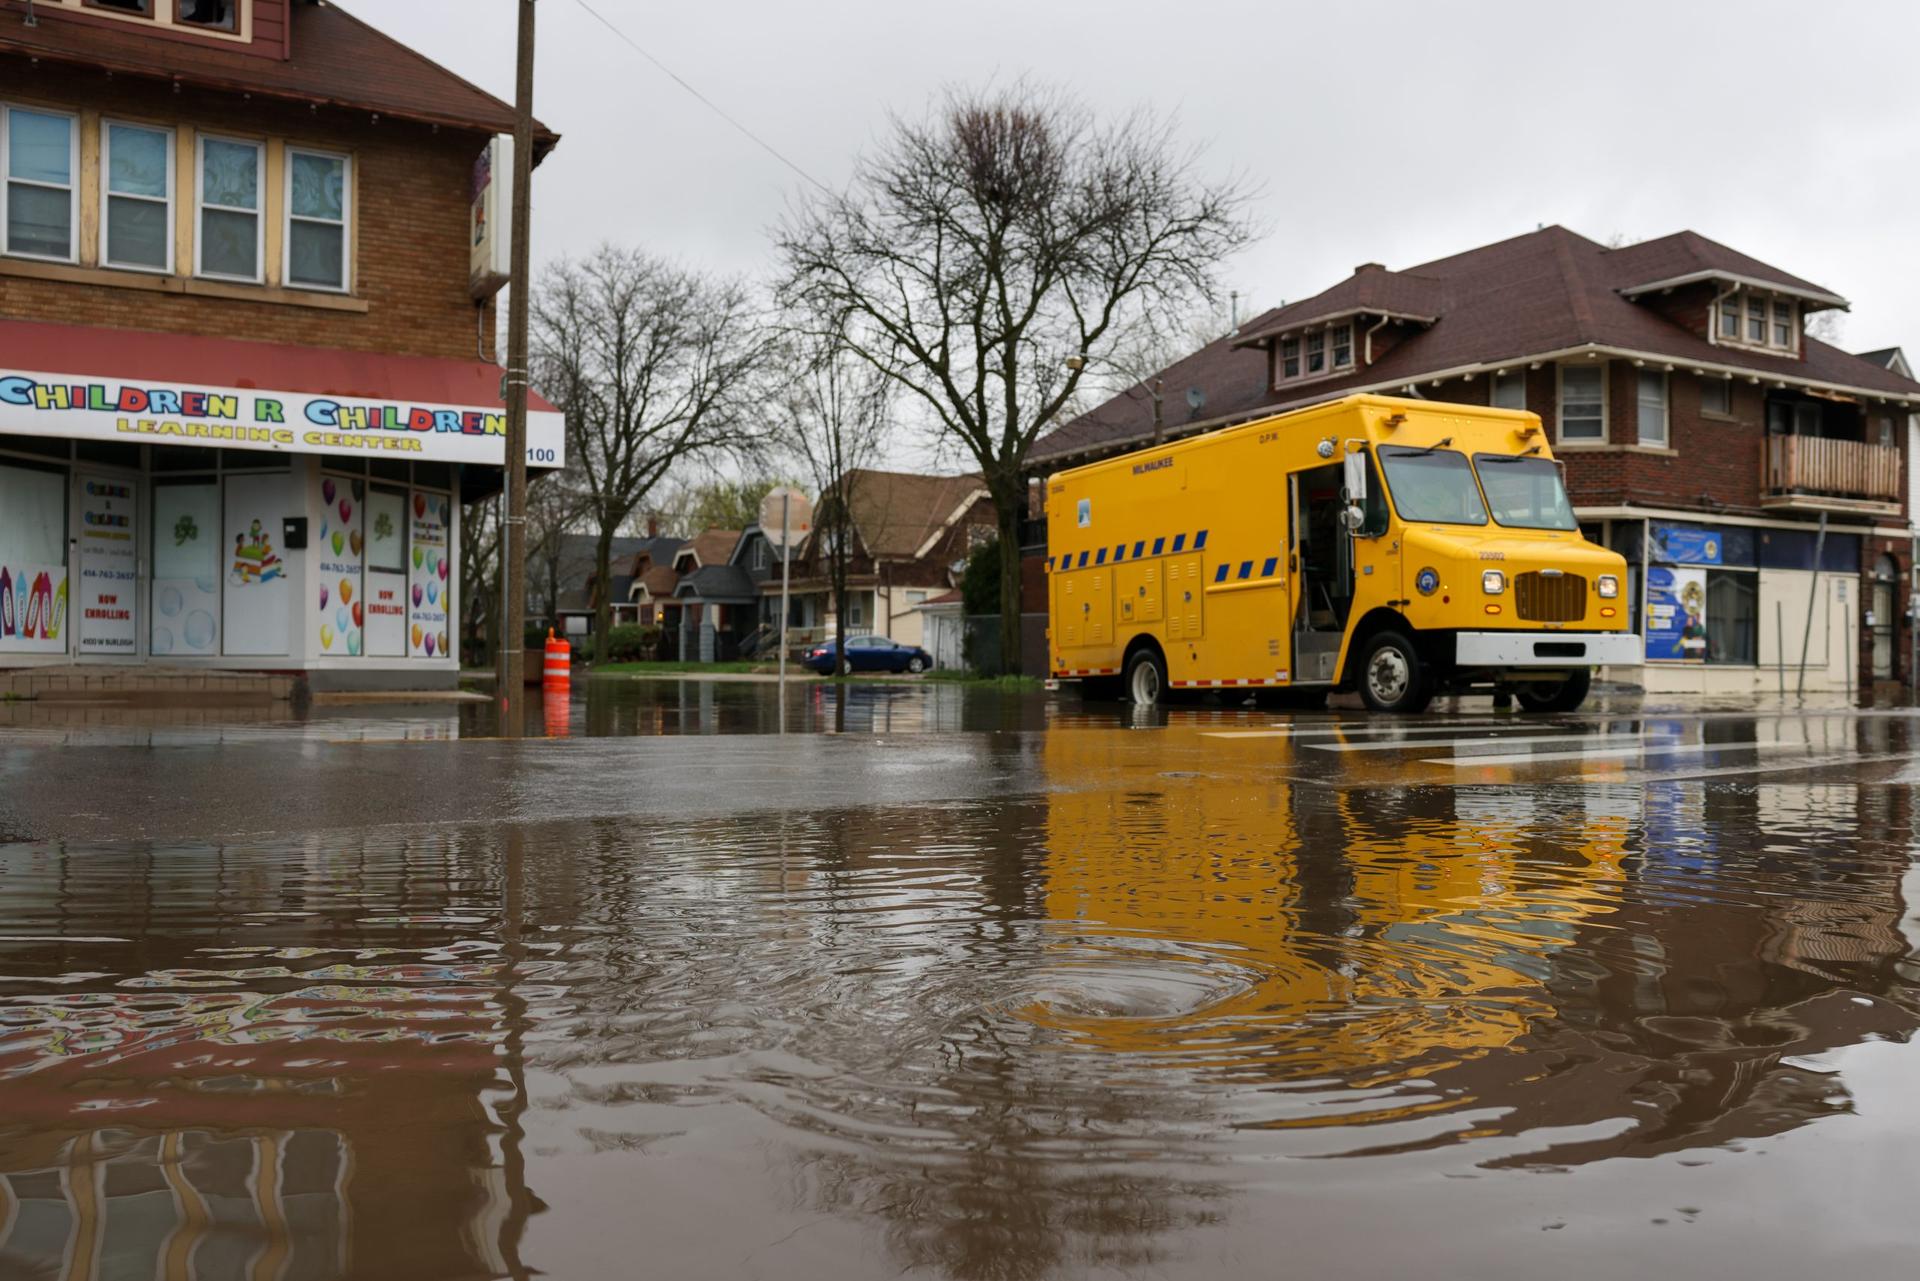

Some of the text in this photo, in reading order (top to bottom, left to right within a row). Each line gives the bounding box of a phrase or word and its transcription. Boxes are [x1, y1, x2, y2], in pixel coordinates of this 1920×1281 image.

[0, 376, 506, 436] CHILDREN R CHILDREN
[116, 418, 422, 451] LEARNING CENTER
[1132, 456, 1173, 475] MILWAUKEE
[98, 595, 117, 604] NOW
[378, 590, 394, 600] NOW
[85, 608, 130, 620] ENROLLING
[368, 604, 403, 616] ENROLLING
